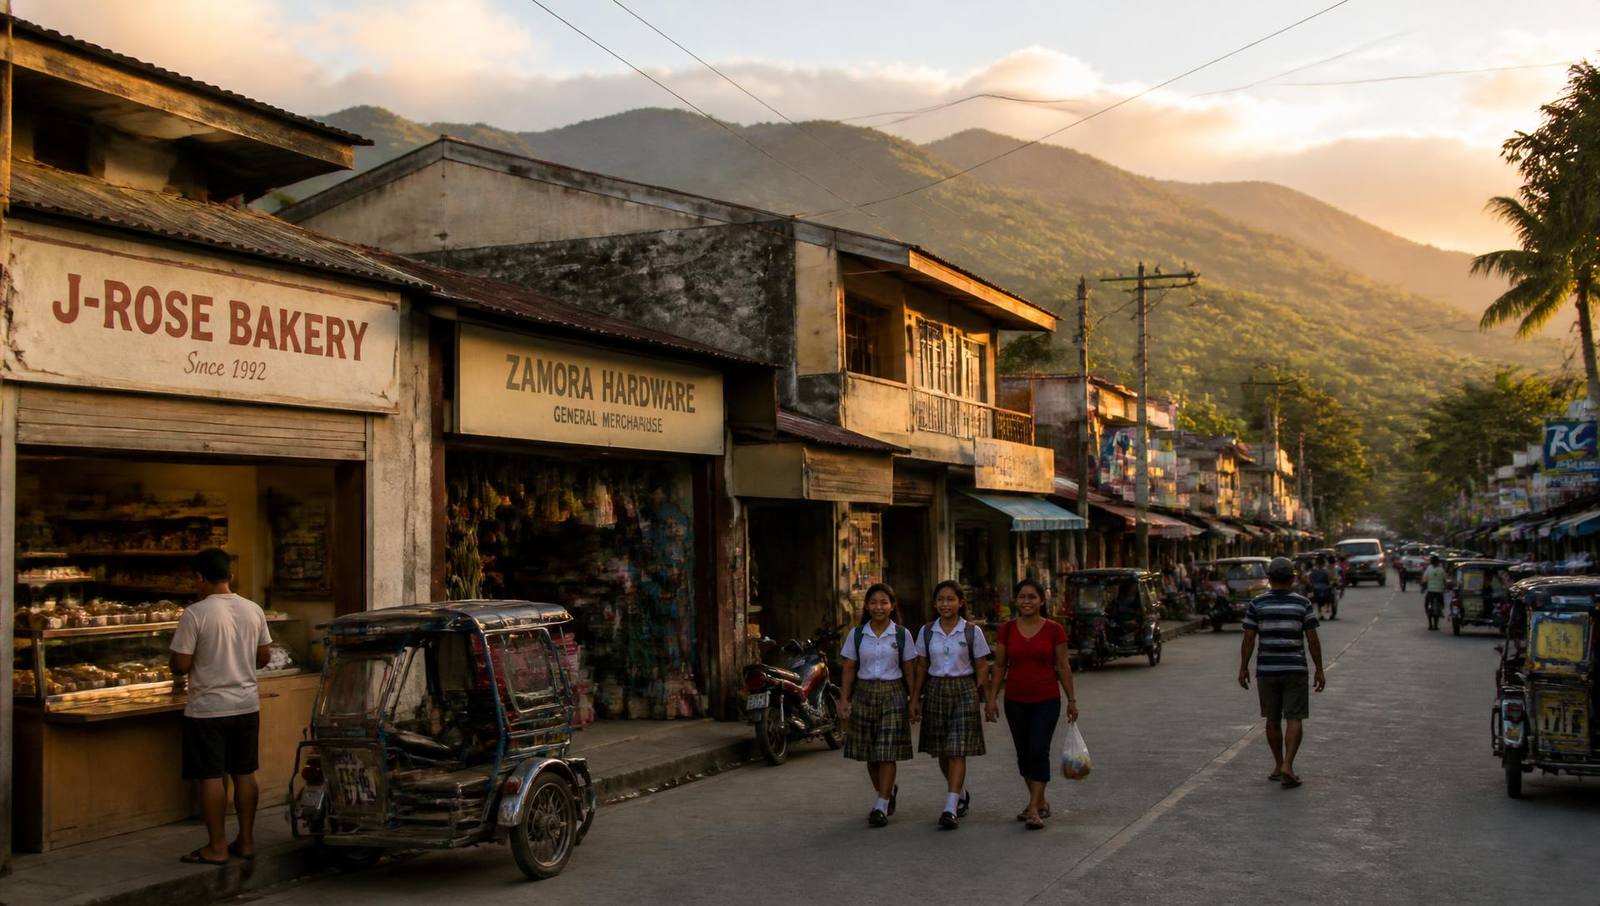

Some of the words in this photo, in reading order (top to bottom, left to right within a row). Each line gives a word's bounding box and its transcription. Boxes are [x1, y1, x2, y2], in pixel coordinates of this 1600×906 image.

[53, 273, 213, 342] J-ROSE
[229, 300, 368, 361] BAKERY
[183, 350, 225, 376] Since
[232, 360, 267, 381] 1992
[506, 353, 594, 400] ZAMORA
[602, 369, 696, 413] HARDWARE
[553, 405, 598, 427] GENERAL
[1543, 423, 1595, 457] RC
